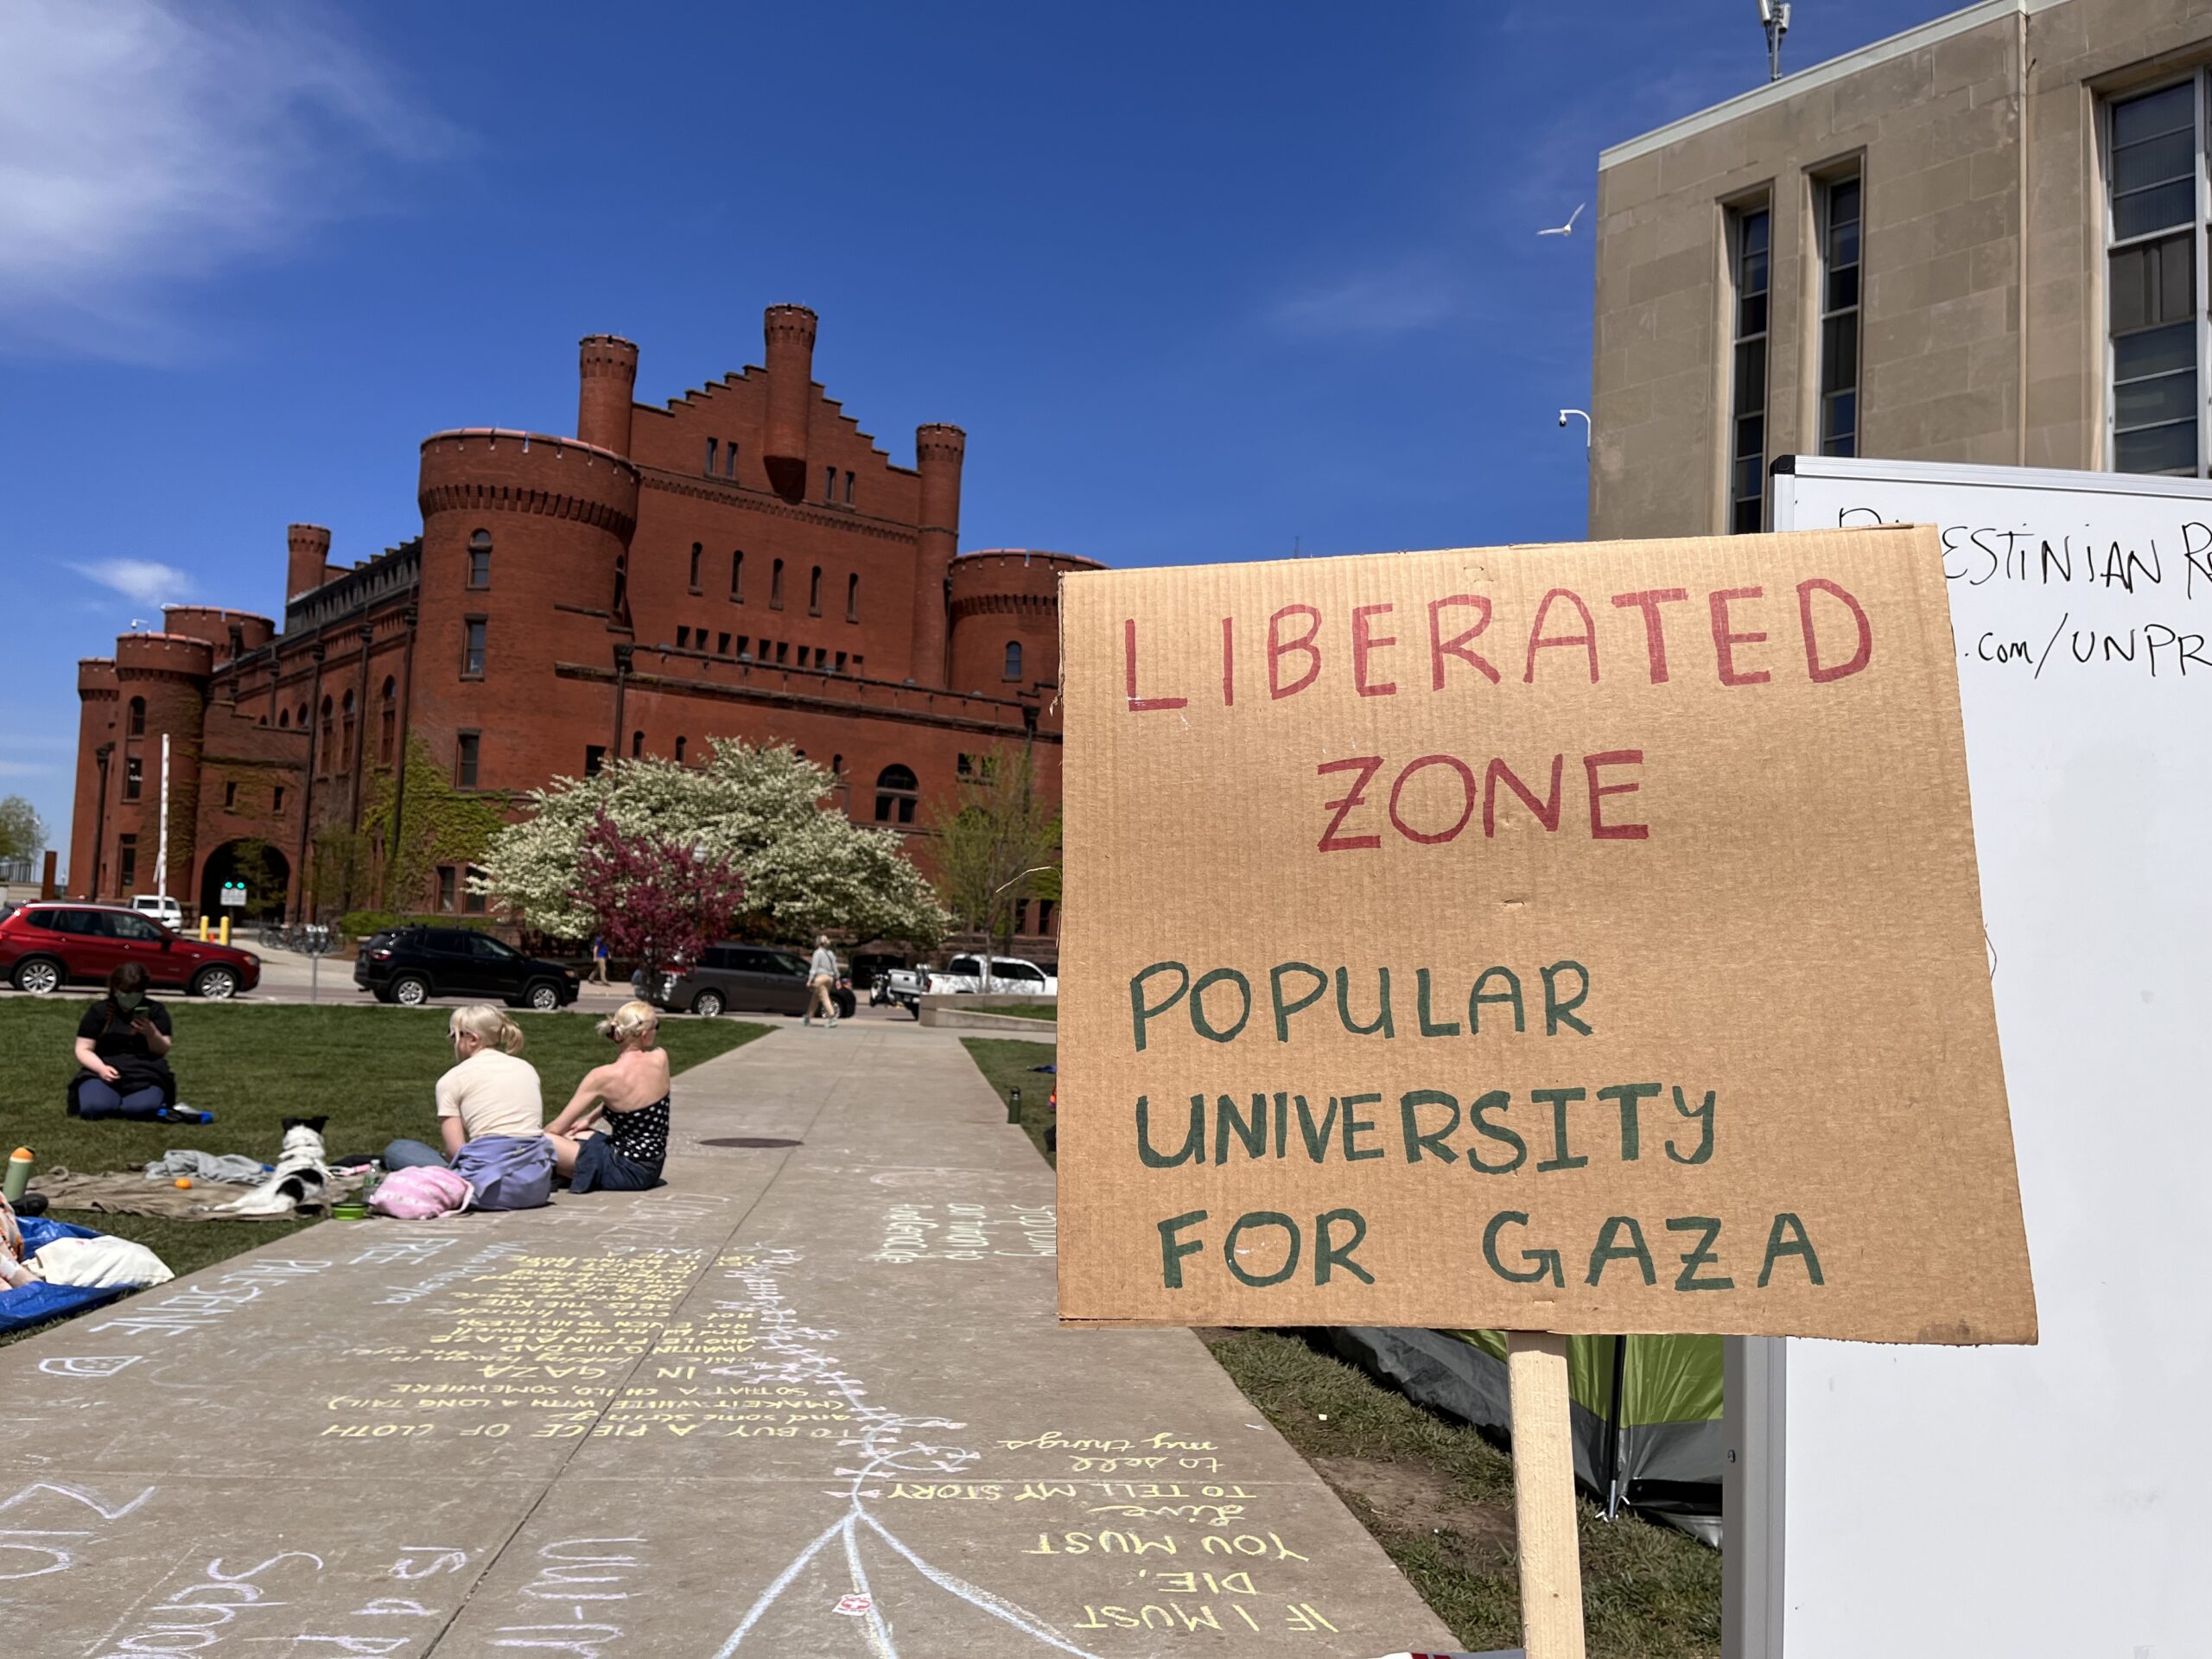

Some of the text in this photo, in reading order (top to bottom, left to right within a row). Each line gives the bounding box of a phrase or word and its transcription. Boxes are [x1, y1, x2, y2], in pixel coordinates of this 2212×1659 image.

[1124, 578, 1872, 712] LIBERATED
[1317, 749, 1649, 853] ZONE
[1130, 960, 1594, 1051] POPULAR
[1135, 1082, 1716, 1175] UNIVERSITY
[1157, 1210, 1825, 1292] FOR GAZA
[86, 1236, 459, 1338] FREE PALESTINE
[475, 1364, 696, 1380] IN GAZA
[388, 1383, 563, 1395] SOMEWHERE
[715, 1386, 772, 1395] THAT
[414, 1398, 492, 1408] LONG
[531, 1399, 595, 1408] WITH
[785, 1413, 851, 1425] and
[320, 1424, 861, 1439] TO BUY A PIECE OF CLOTH
[997, 1431, 1218, 1452] my things
[1067, 1455, 1225, 1473] to sell
[887, 1483, 1257, 1501] TO TELL MY STORY
[1020, 1529, 1310, 1562] YOU MUST
[1072, 1603, 1339, 1632] IF I MUST
